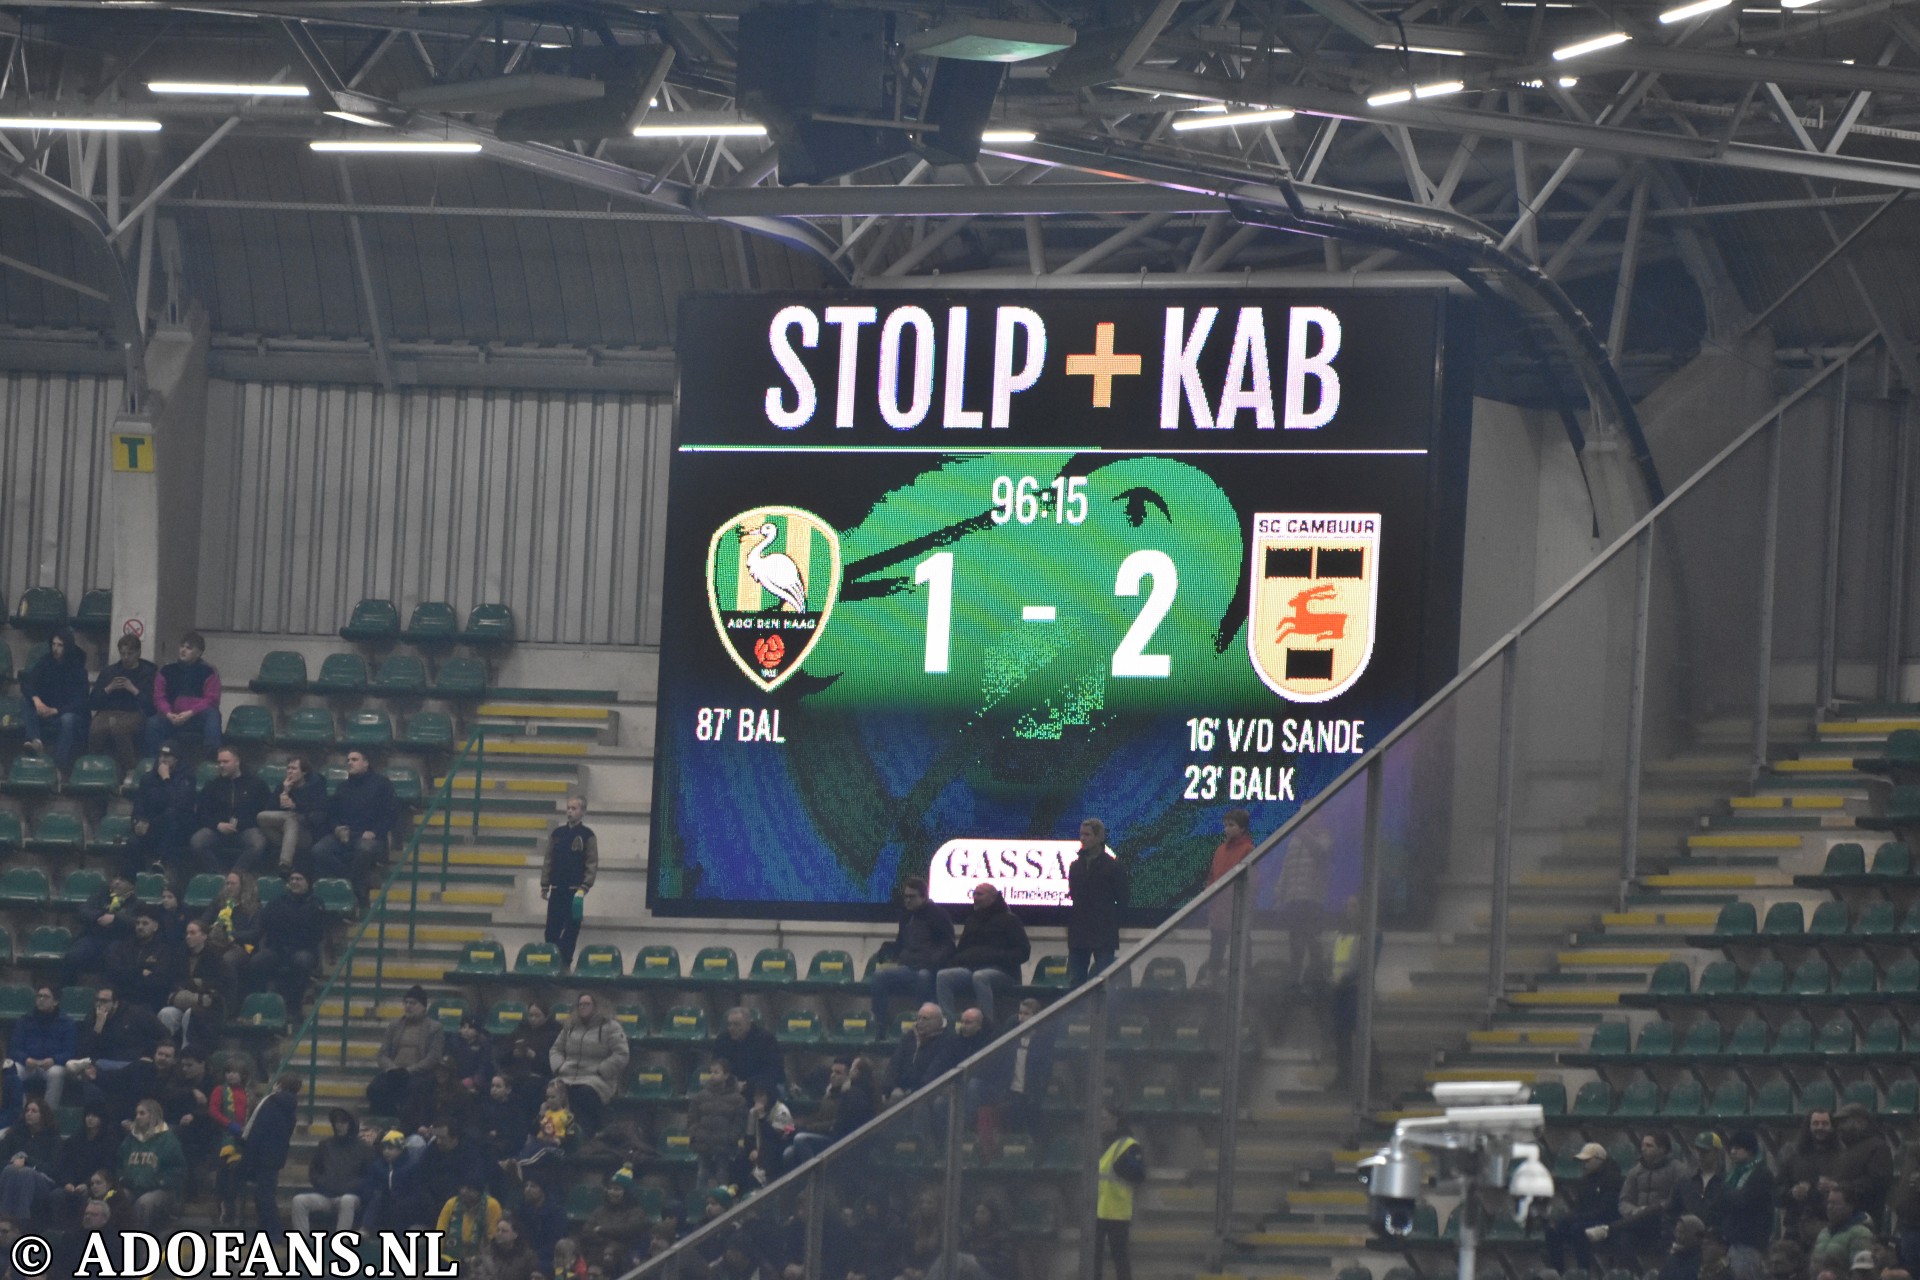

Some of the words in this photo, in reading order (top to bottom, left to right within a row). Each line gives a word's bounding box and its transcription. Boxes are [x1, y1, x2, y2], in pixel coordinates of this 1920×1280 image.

[765, 305, 1047, 429] STOLP
[1066, 322, 1141, 408] +
[1160, 306, 1342, 429] KAB
[120, 436, 145, 468] T
[991, 475, 1088, 525] 96:15
[1259, 519, 1281, 533] SC
[1287, 519, 1375, 534] CAMBUUR
[756, 617, 780, 630] DEN
[783, 617, 816, 630] HAAG
[915, 552, 954, 673] 1
[1111, 549, 1178, 679] 2
[696, 707, 732, 741] 87'
[737, 707, 786, 743] BAL
[1187, 717, 1221, 752] 16'
[1227, 717, 1274, 753] V/D
[1282, 718, 1365, 754] SANDE
[1184, 764, 1224, 800] 23'
[1230, 765, 1296, 801] BALK
[945, 847, 1074, 880] GASSA
